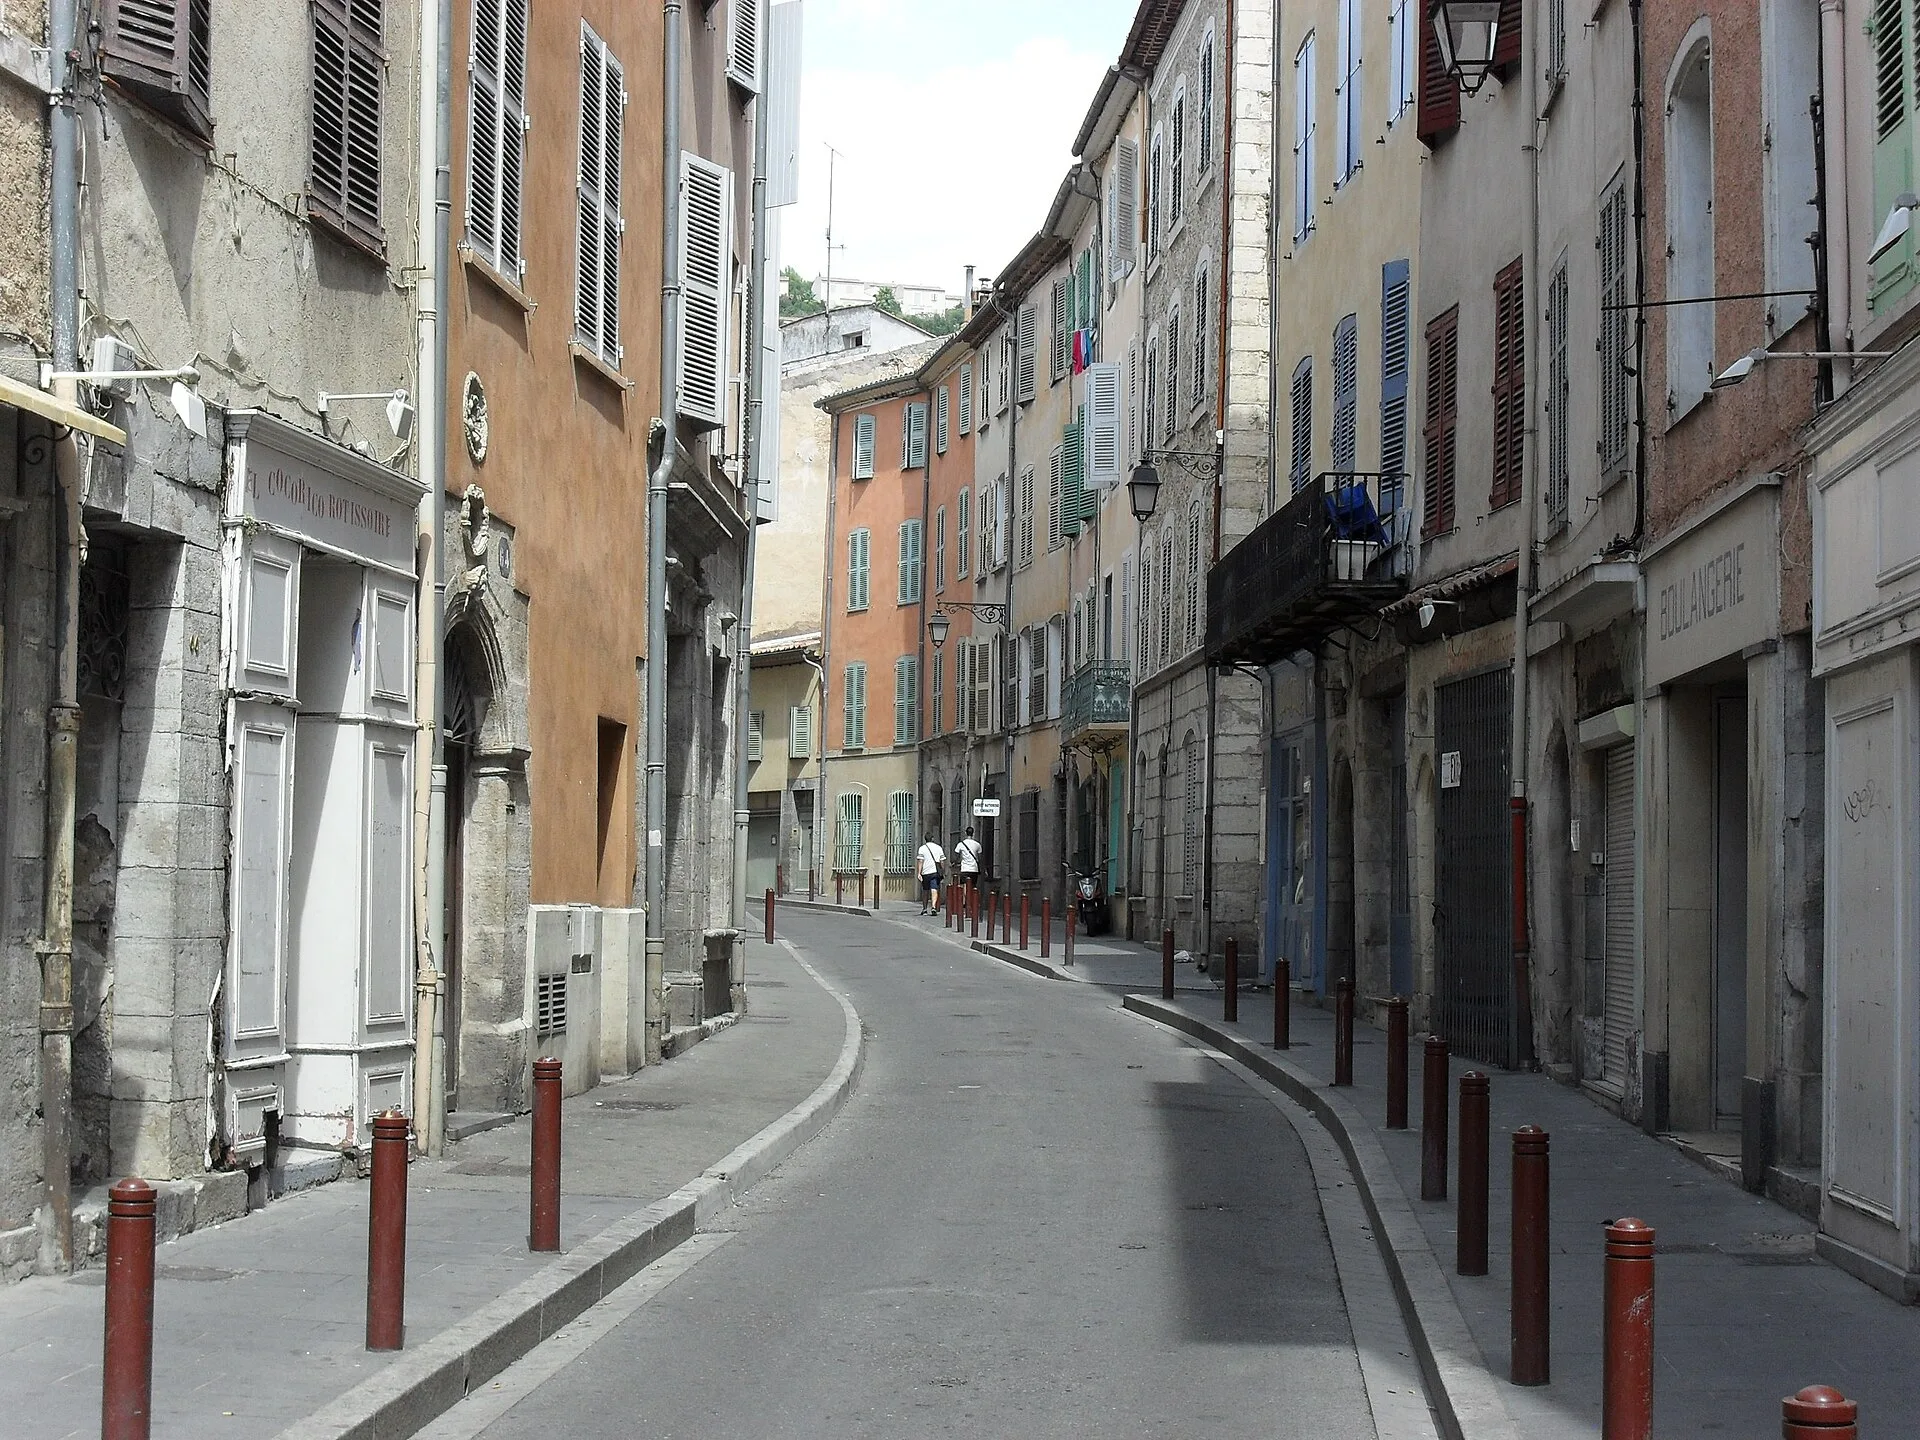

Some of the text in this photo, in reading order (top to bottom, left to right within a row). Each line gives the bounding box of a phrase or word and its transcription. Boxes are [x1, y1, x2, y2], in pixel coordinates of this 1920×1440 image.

[268, 468, 325, 519] COCORICO
[329, 493, 391, 538] ROTISSOIRE
[1660, 542, 1745, 641] BOULANGERIE
